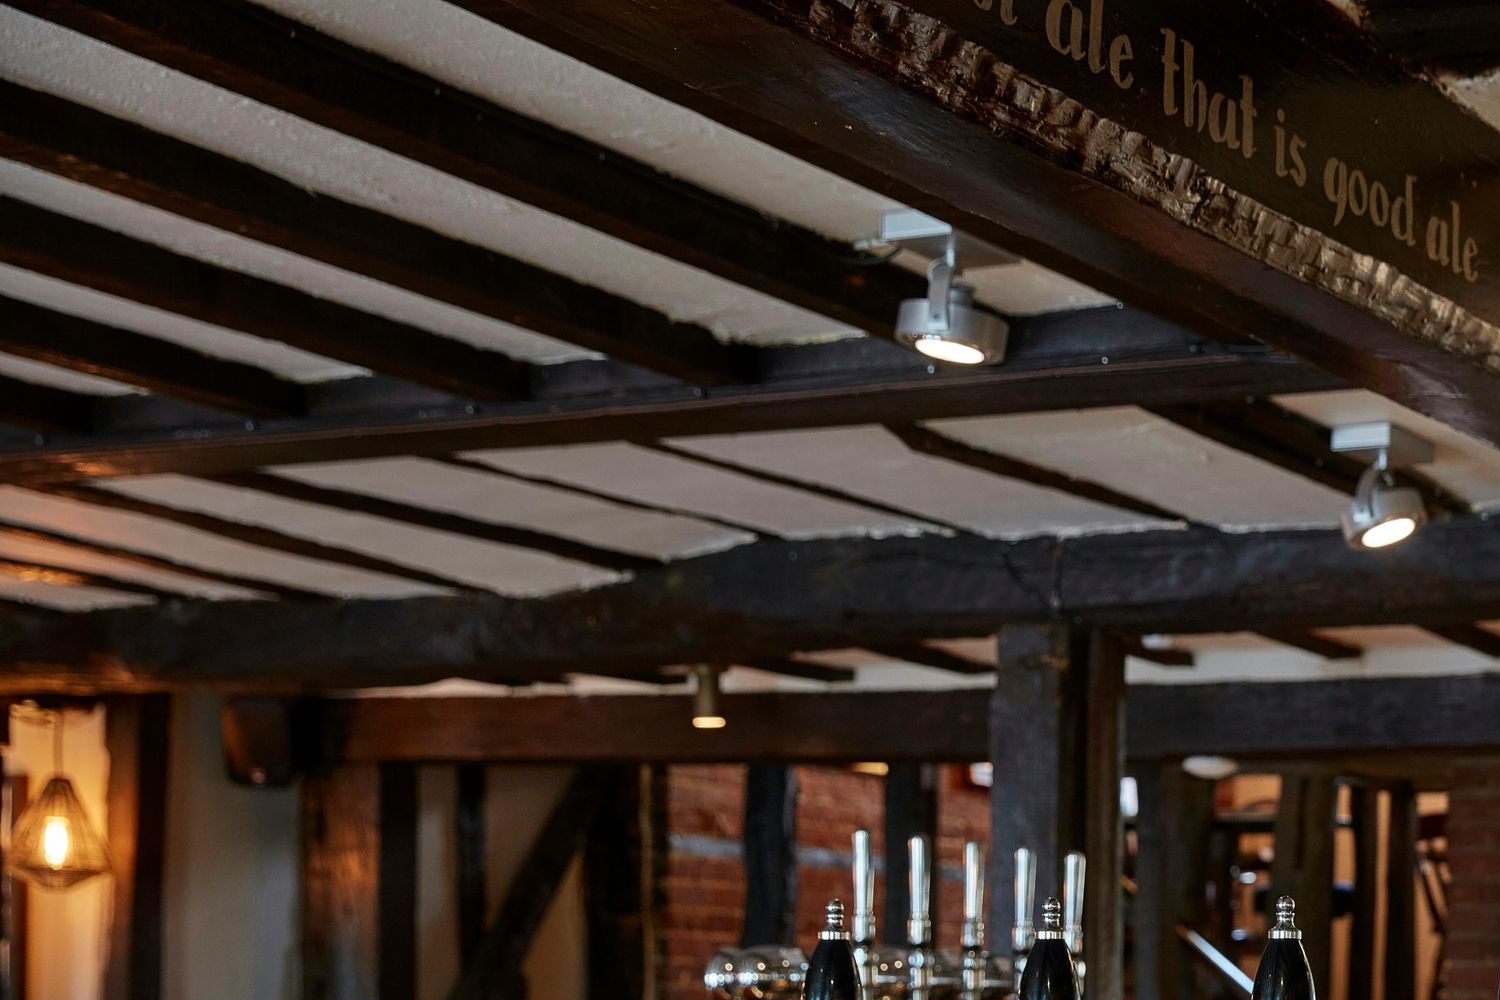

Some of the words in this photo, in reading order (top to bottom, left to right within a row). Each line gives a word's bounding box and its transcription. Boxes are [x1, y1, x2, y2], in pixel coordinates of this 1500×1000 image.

[1045, 0, 1135, 89] ale
[1160, 27, 1257, 159] that
[1273, 107, 1307, 187] is
[1323, 156, 1418, 248] good
[1425, 200, 1479, 282] ale
